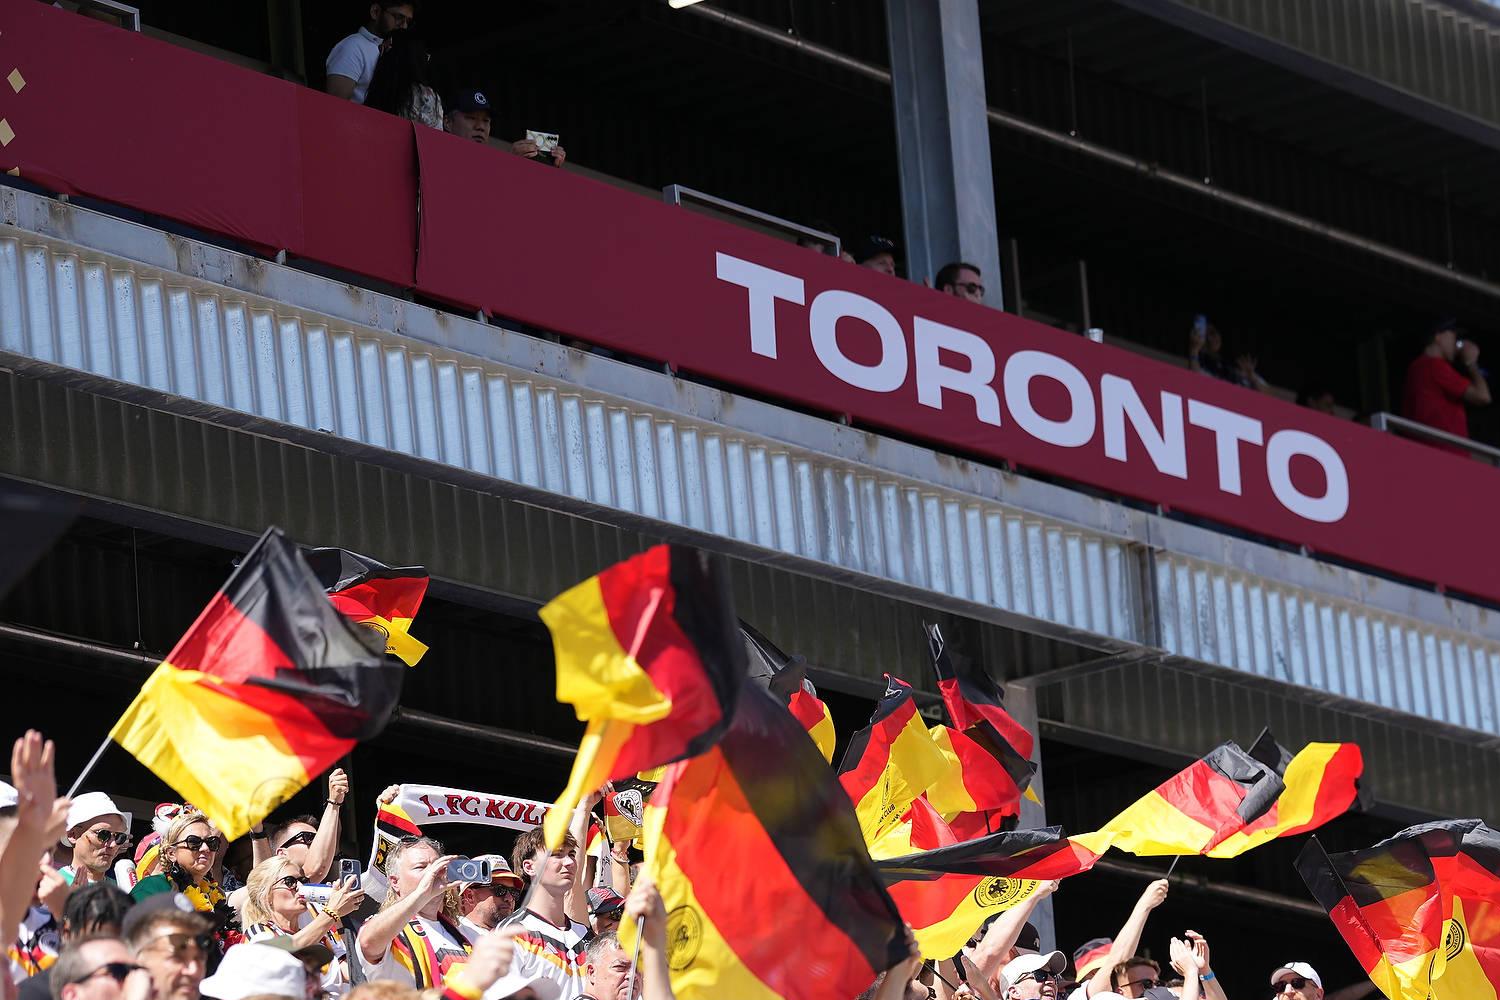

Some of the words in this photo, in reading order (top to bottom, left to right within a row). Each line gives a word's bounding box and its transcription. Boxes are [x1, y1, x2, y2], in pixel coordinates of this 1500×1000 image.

[715, 251, 1349, 523] TORONTO
[445, 794, 480, 817] FC
[485, 798, 549, 825] KOL
